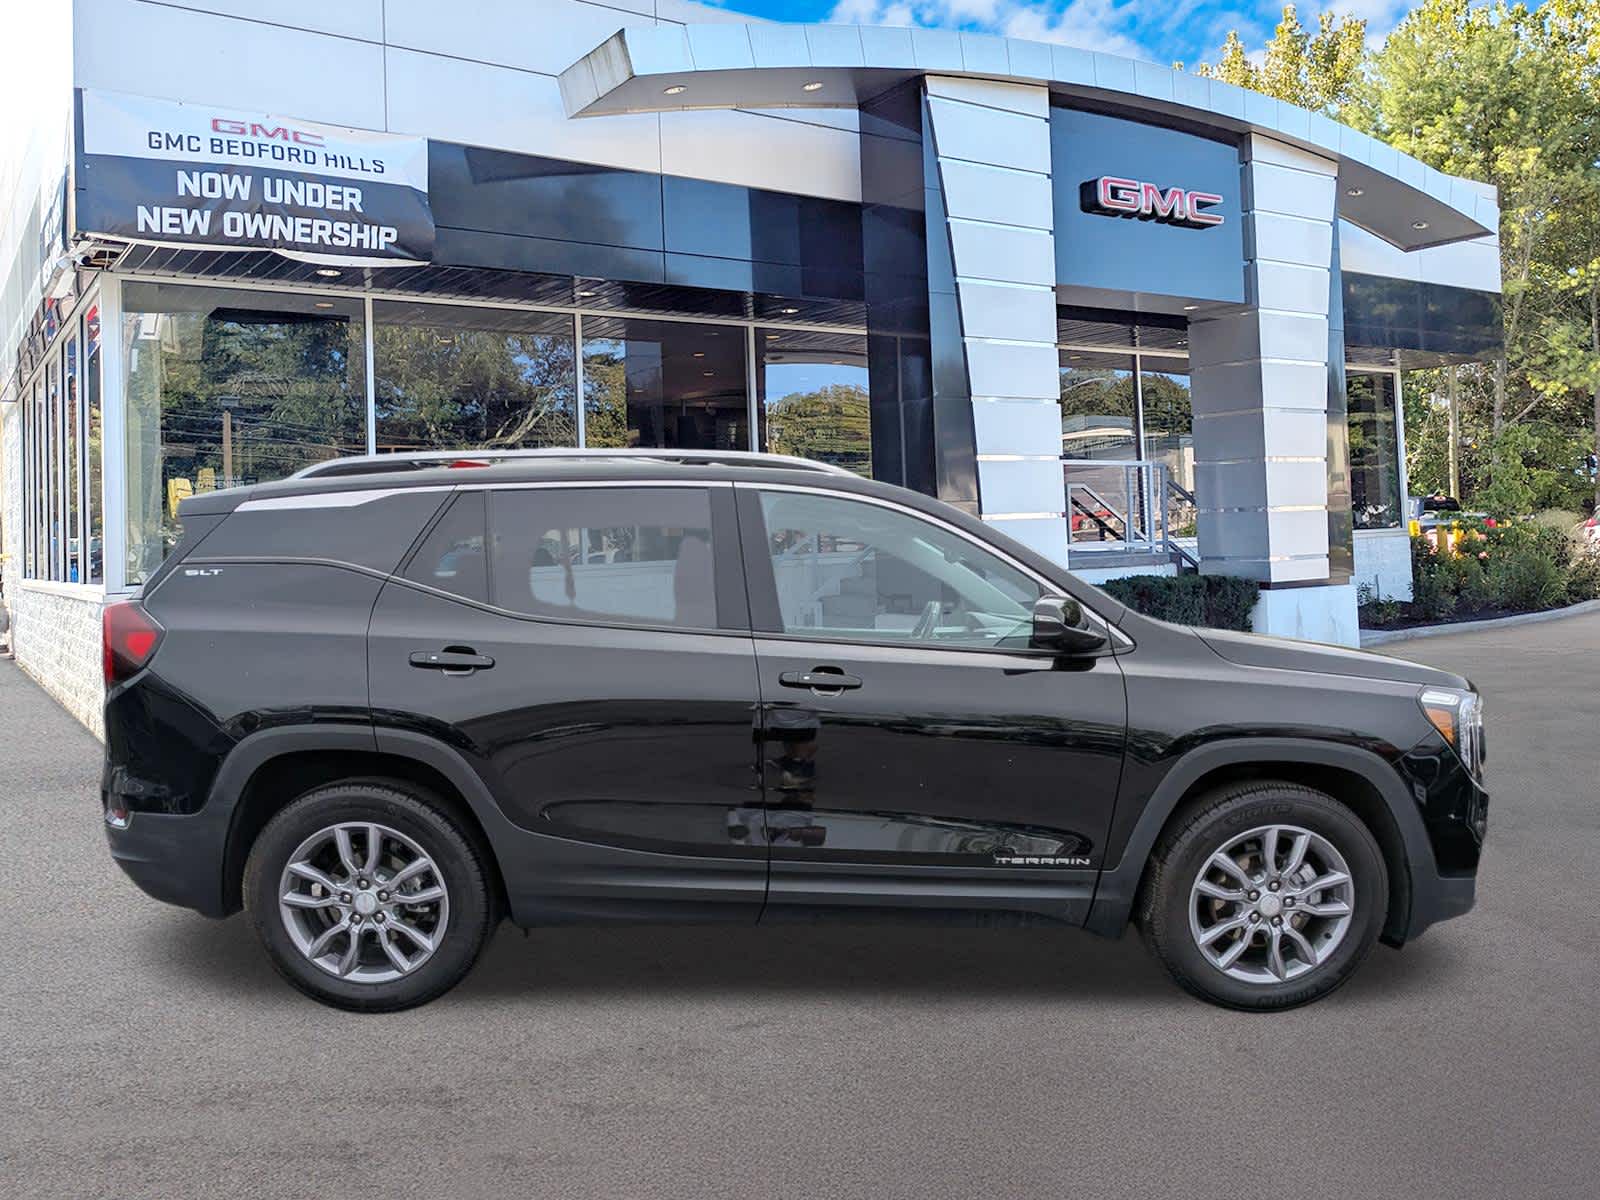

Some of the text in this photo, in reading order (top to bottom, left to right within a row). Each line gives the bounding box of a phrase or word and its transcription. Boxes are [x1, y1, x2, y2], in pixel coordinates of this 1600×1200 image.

[148, 131, 385, 174] GMC BEDFORD HILLS
[211, 117, 326, 148] GMC
[177, 170, 364, 213] NOW UNDER
[1097, 175, 1224, 225] GMC
[136, 205, 398, 251] NEW OWNERSHIP
[184, 568, 223, 576] SLT
[994, 857, 1090, 865] TERRAIN
